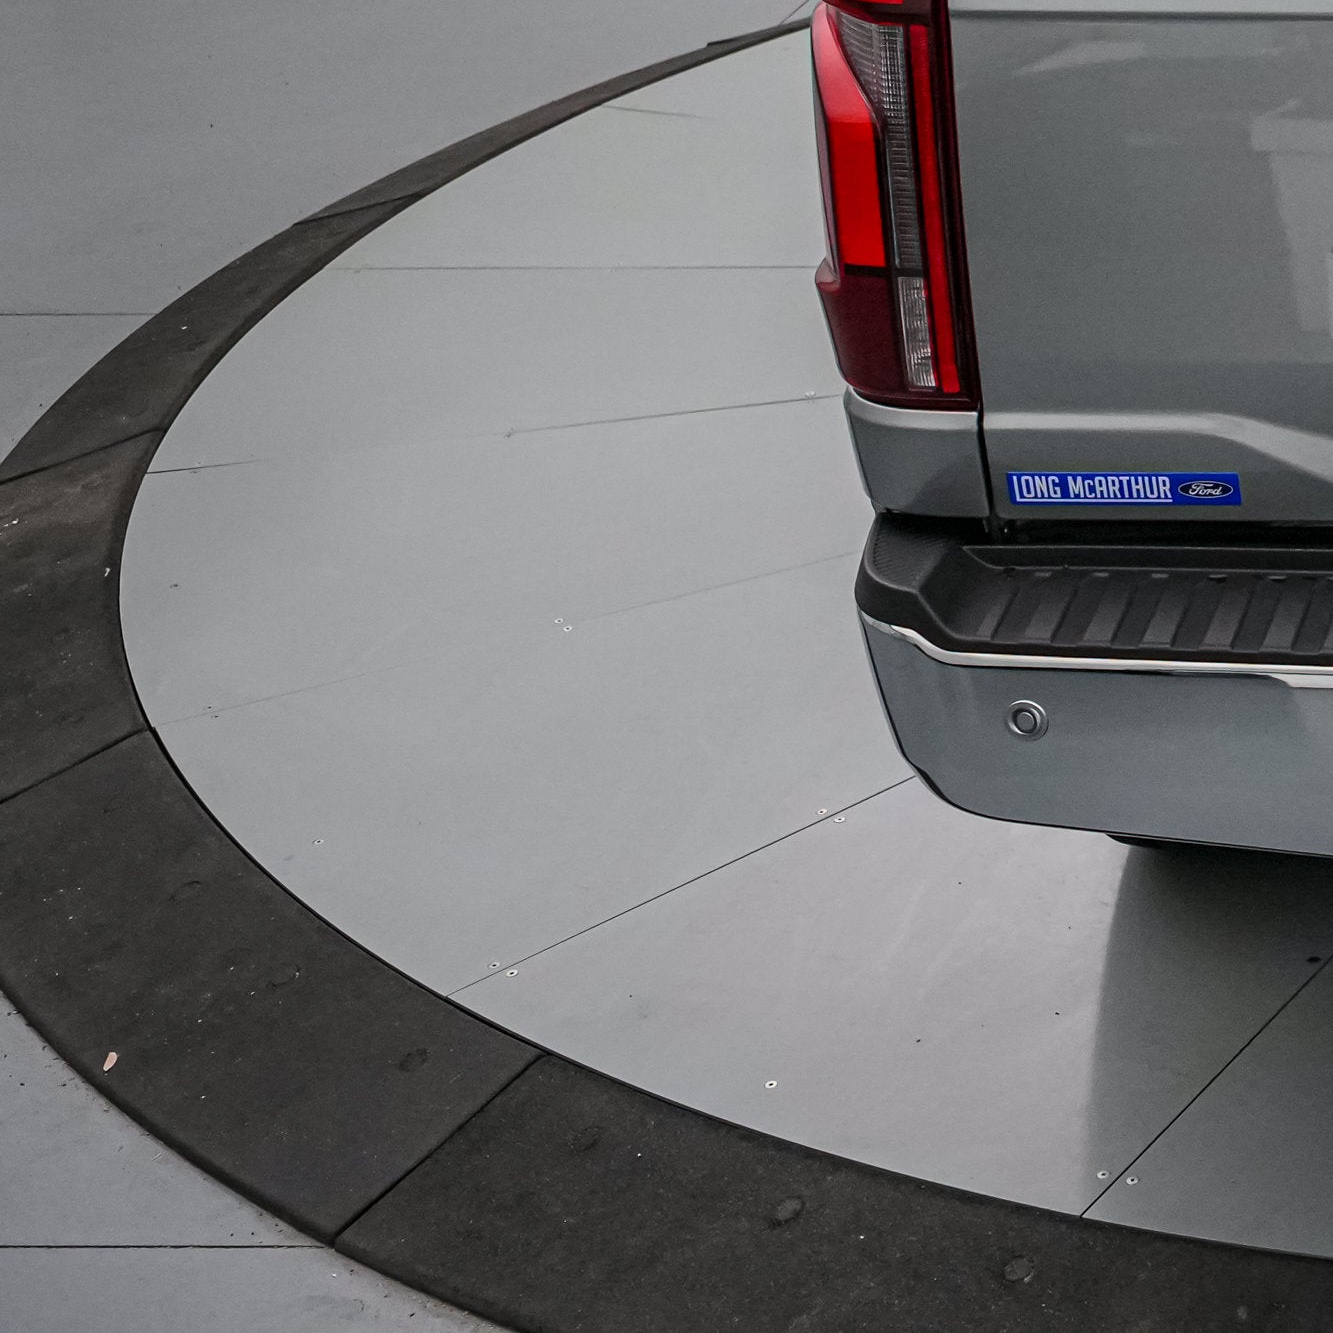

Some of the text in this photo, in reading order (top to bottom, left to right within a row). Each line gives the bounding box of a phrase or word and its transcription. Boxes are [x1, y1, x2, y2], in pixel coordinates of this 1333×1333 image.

[1012, 475, 1223, 501] LONG McARTHUR Ford
